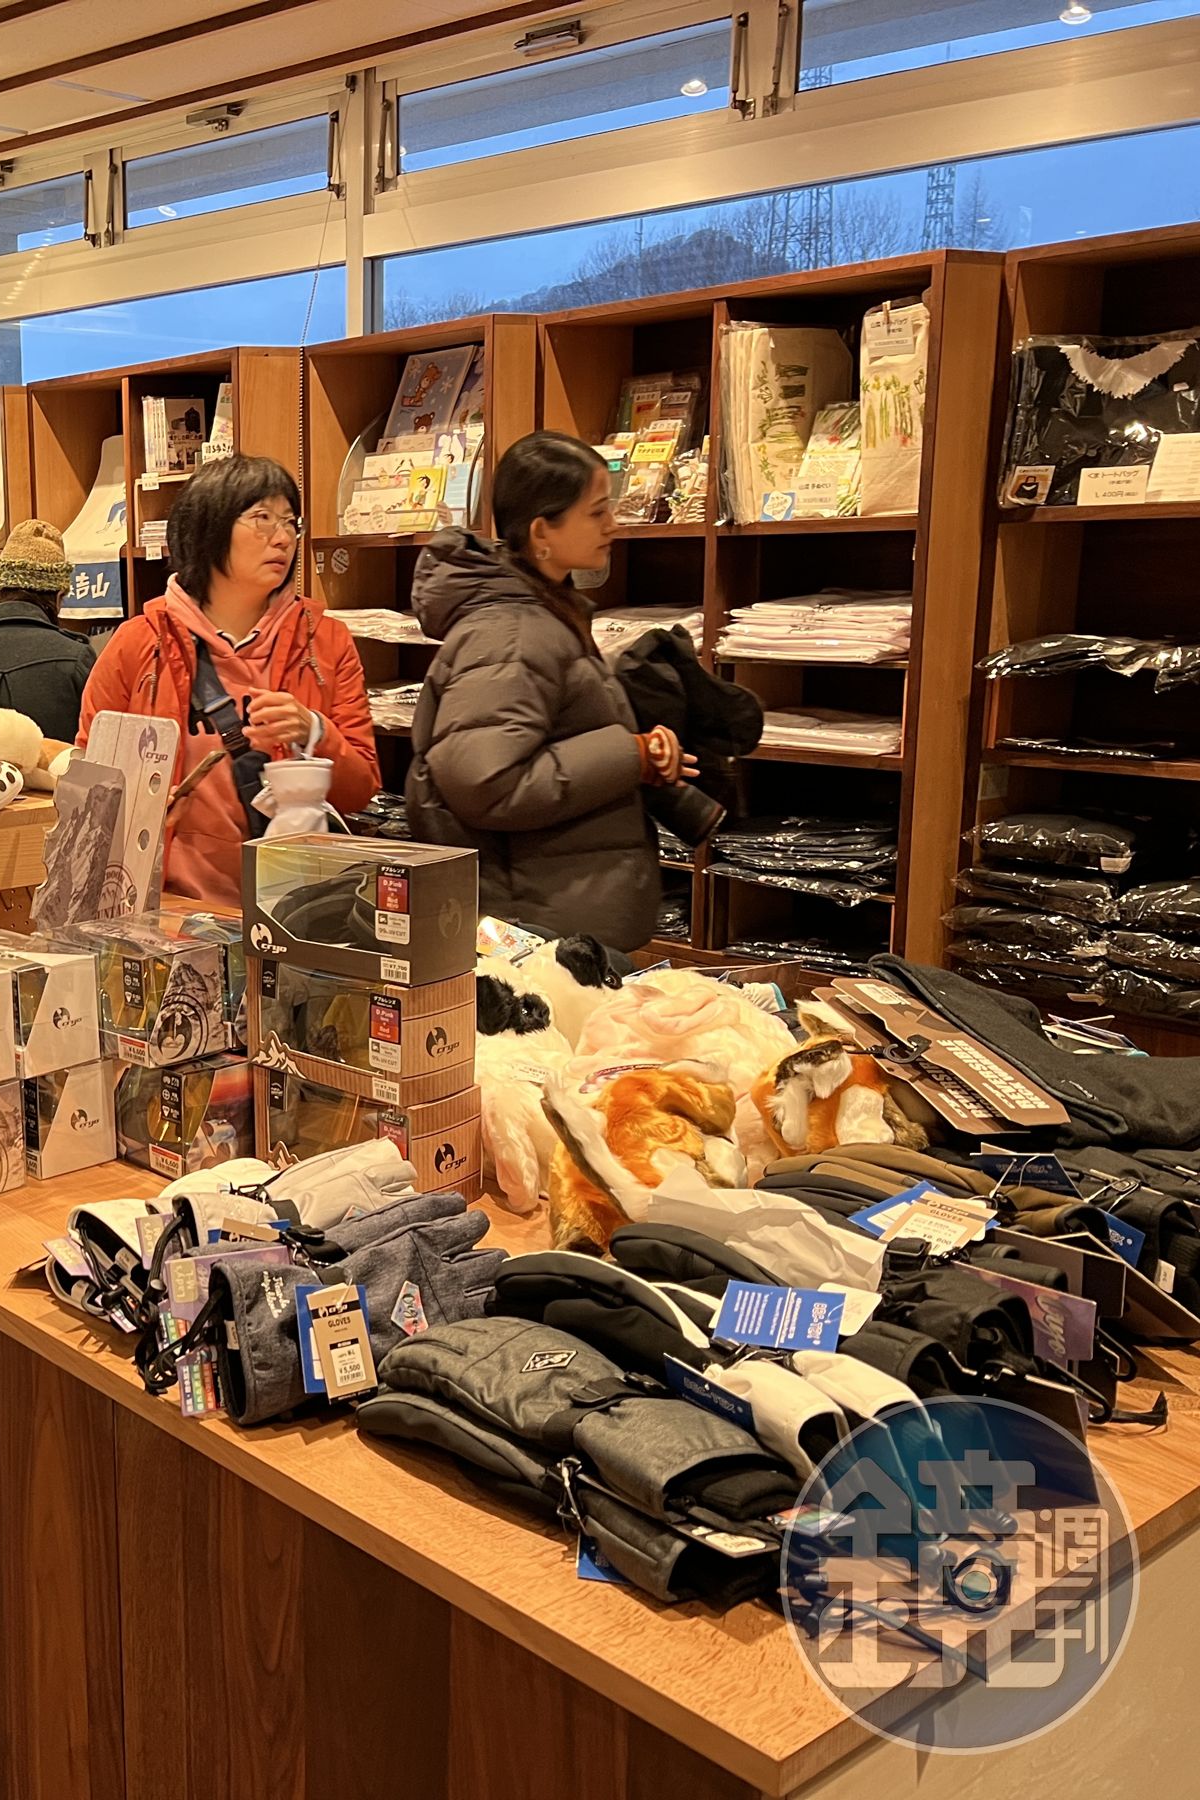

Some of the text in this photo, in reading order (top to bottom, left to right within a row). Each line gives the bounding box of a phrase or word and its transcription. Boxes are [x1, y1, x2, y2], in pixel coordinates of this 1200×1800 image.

[67, 572, 111, 600] 吉山
[145, 751, 169, 764] cryo
[261, 943, 288, 954] cryo
[437, 1041, 460, 1055] cryo
[937, 1039, 1034, 1109] REVERSIBLE
[445, 1156, 467, 1170] cryo
[930, 1209, 963, 1222] GLOVES
[328, 1316, 351, 1328] GLOVES
[339, 1363, 361, 1374] ¥5,500
